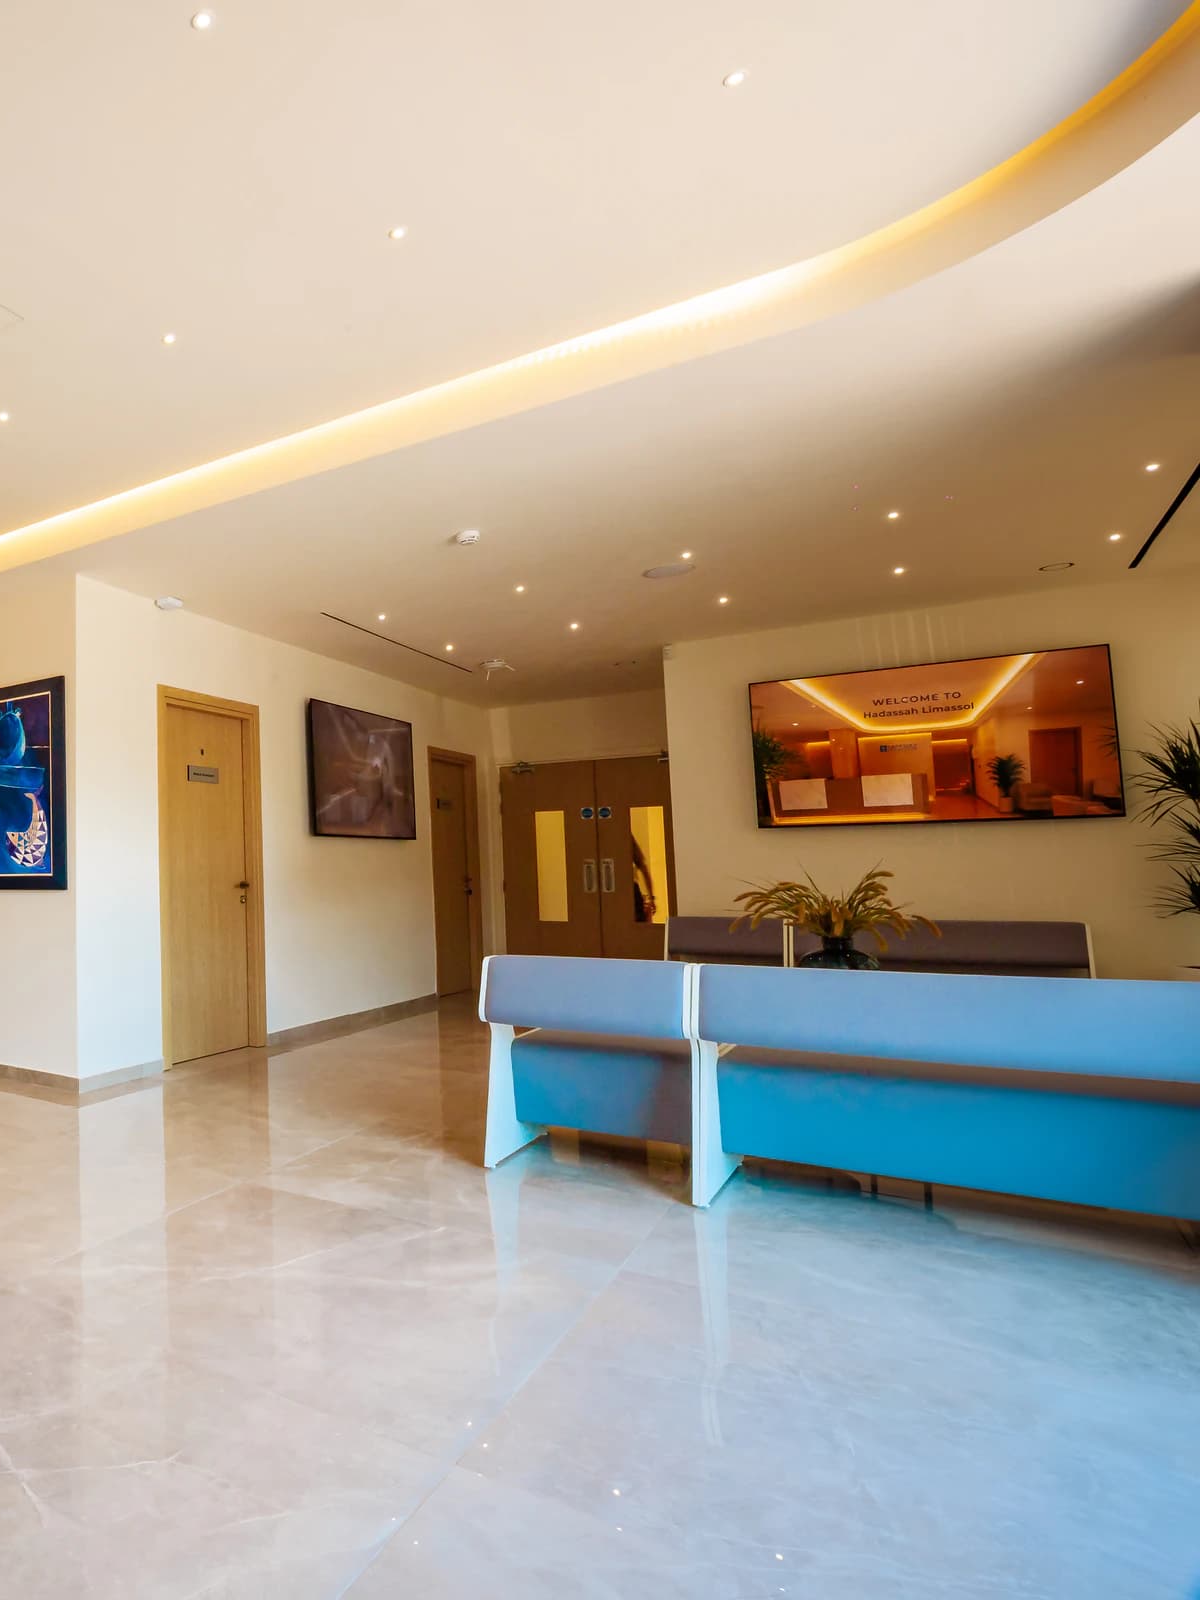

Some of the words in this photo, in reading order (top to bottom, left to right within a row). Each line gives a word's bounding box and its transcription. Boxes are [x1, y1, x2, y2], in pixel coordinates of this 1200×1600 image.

[872, 693, 940, 706] WELCOME
[944, 691, 961, 700] TO
[863, 707, 919, 719] Hadassah
[922, 702, 974, 714] Limassol
